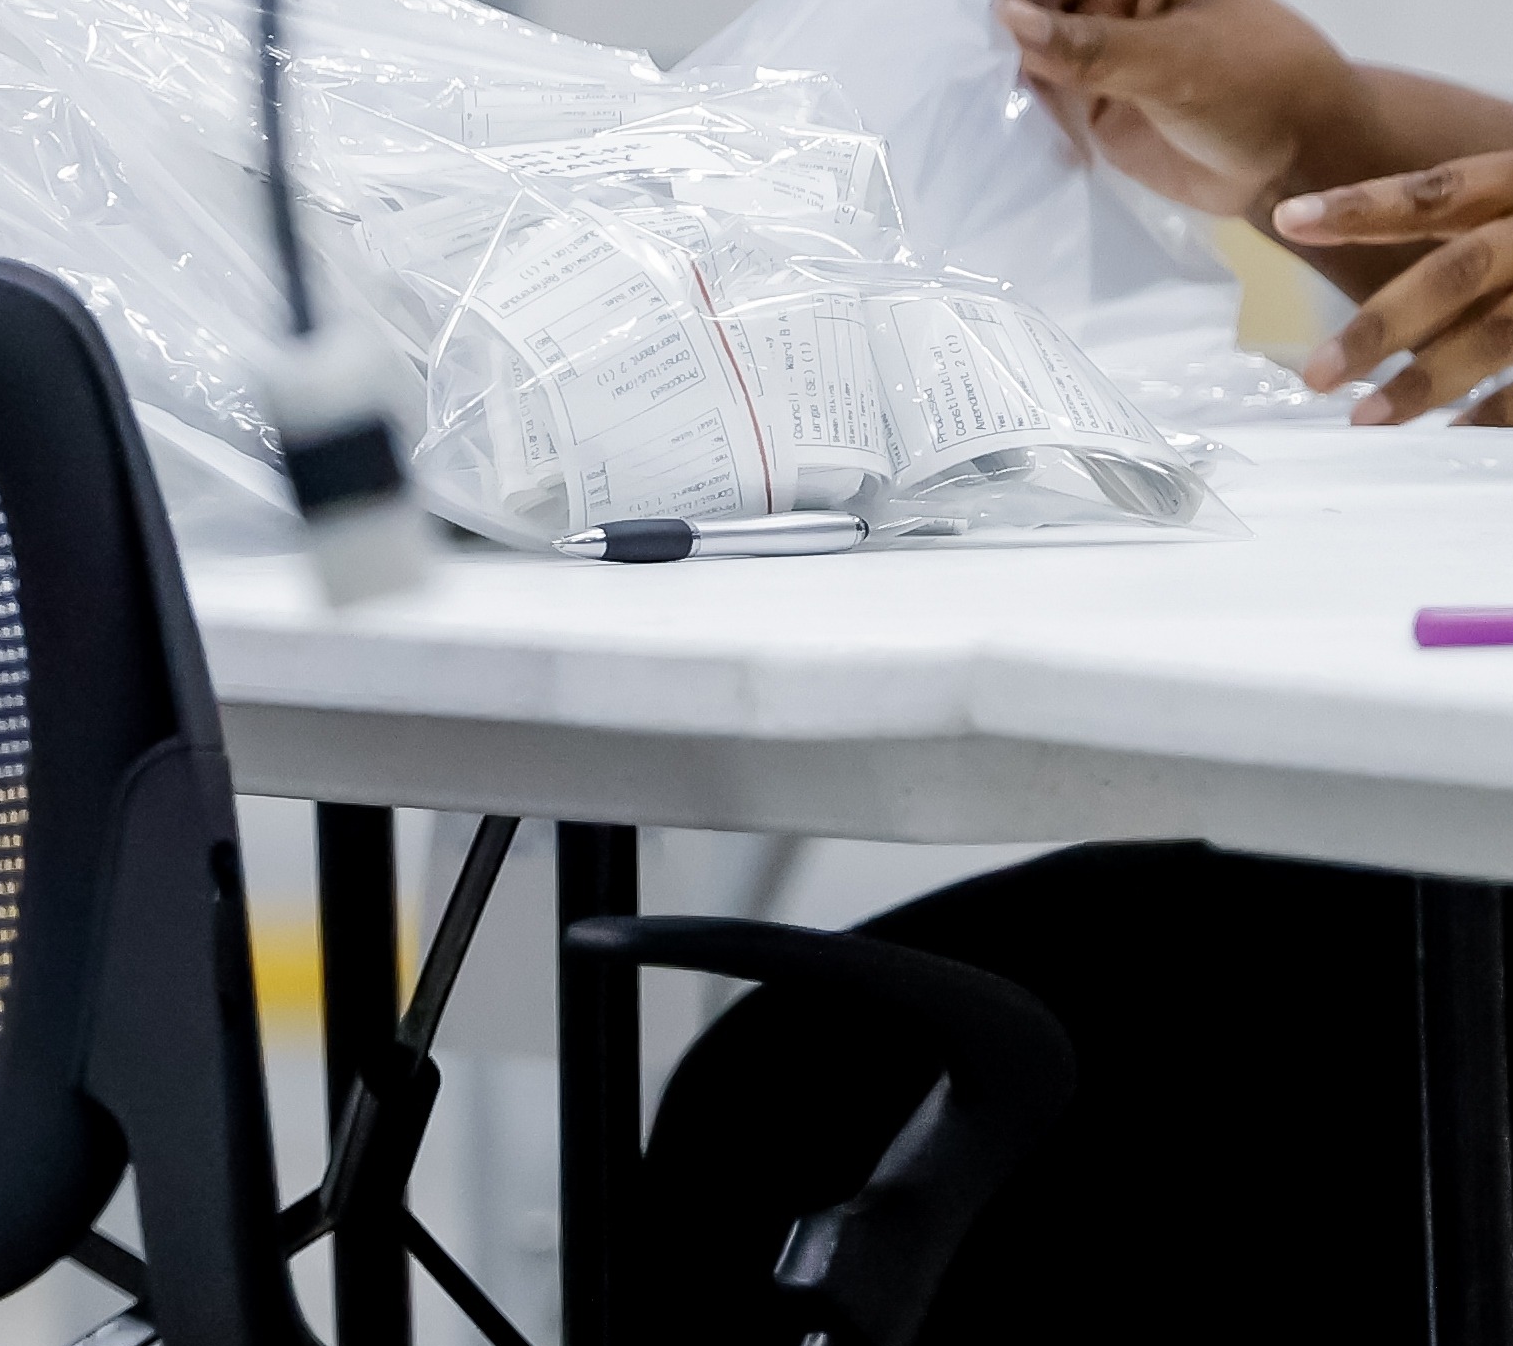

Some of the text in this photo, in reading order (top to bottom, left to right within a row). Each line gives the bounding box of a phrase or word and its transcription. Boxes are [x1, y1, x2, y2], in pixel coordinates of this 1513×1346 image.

[628, 328, 683, 367] Amendment
[782, 341, 795, 370] Ward
[797, 340, 815, 363] (1)
[944, 333, 962, 352] (1)
[593, 366, 618, 388] (1)
[608, 347, 692, 402] Constitutional
[648, 364, 701, 402] Proposed
[929, 344, 966, 436] Constitutional
[787, 391, 803, 439] Council
[923, 387, 947, 442] Proposed
[960, 371, 986, 429] Amendment
[808, 403, 822, 440] Large
